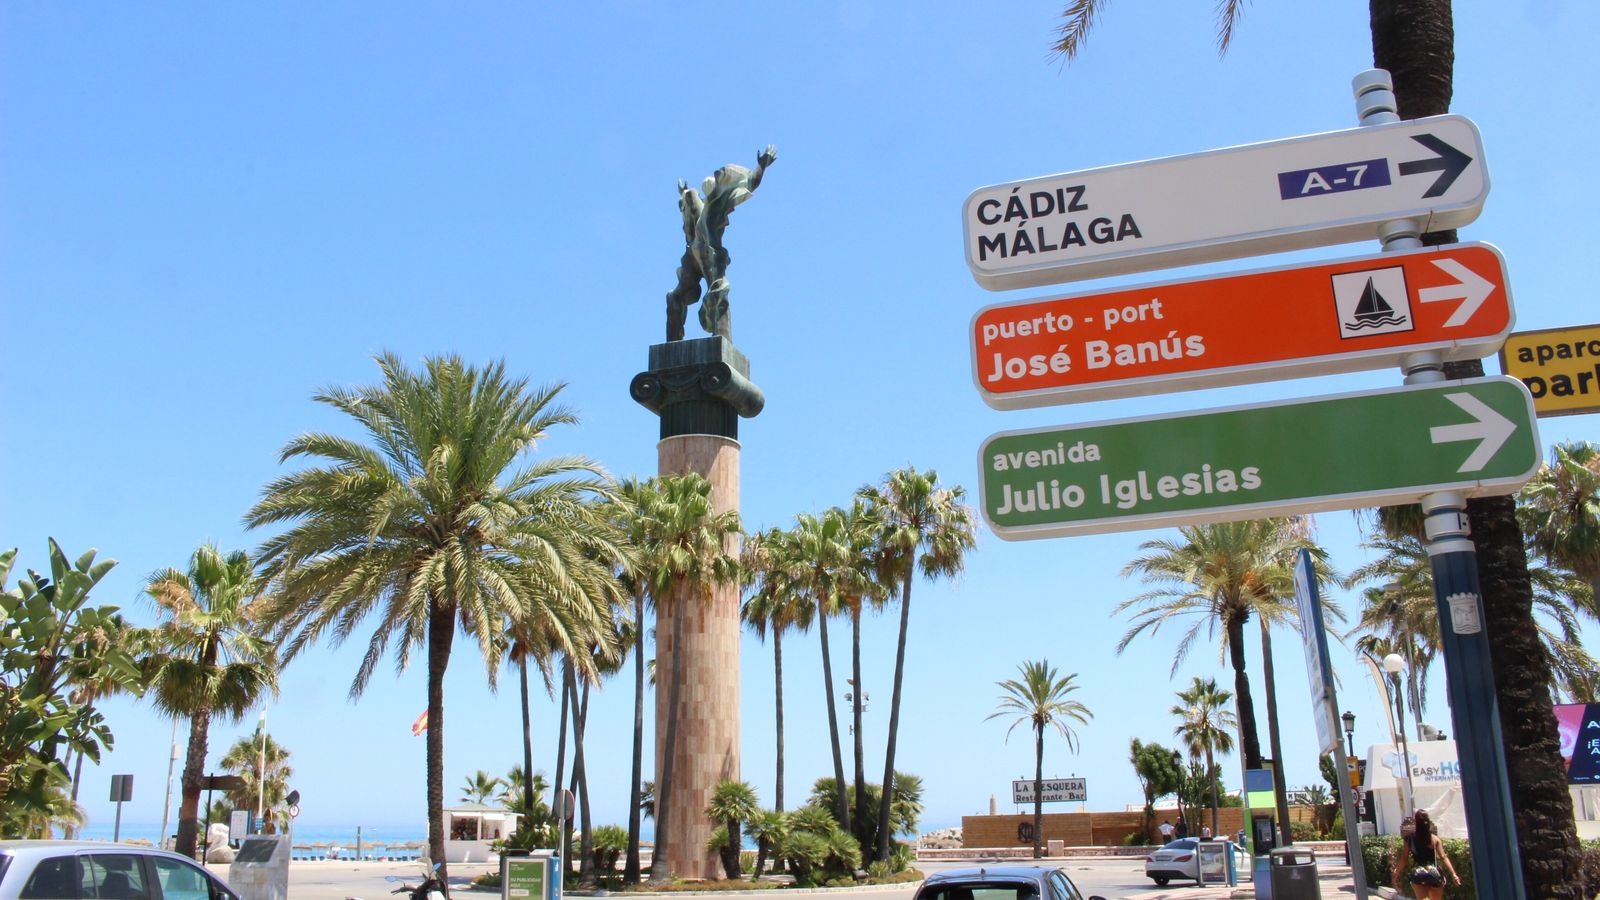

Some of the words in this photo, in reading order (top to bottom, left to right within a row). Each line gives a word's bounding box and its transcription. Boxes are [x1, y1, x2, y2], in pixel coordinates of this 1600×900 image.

[1301, 164, 1369, 195] A-7
[977, 184, 1089, 226] CÁDIZ
[978, 213, 1143, 262] MÁLAGA
[983, 312, 1073, 346] puerto
[1103, 298, 1164, 330] port
[987, 343, 1071, 382] José
[1085, 329, 1206, 369] Banús
[1518, 340, 1600, 367] aparc
[1521, 363, 1600, 399] par
[993, 441, 1101, 471] avenida
[996, 479, 1085, 515] Julio
[1100, 463, 1262, 510] Iglesias
[1068, 791, 1084, 800] Bar
